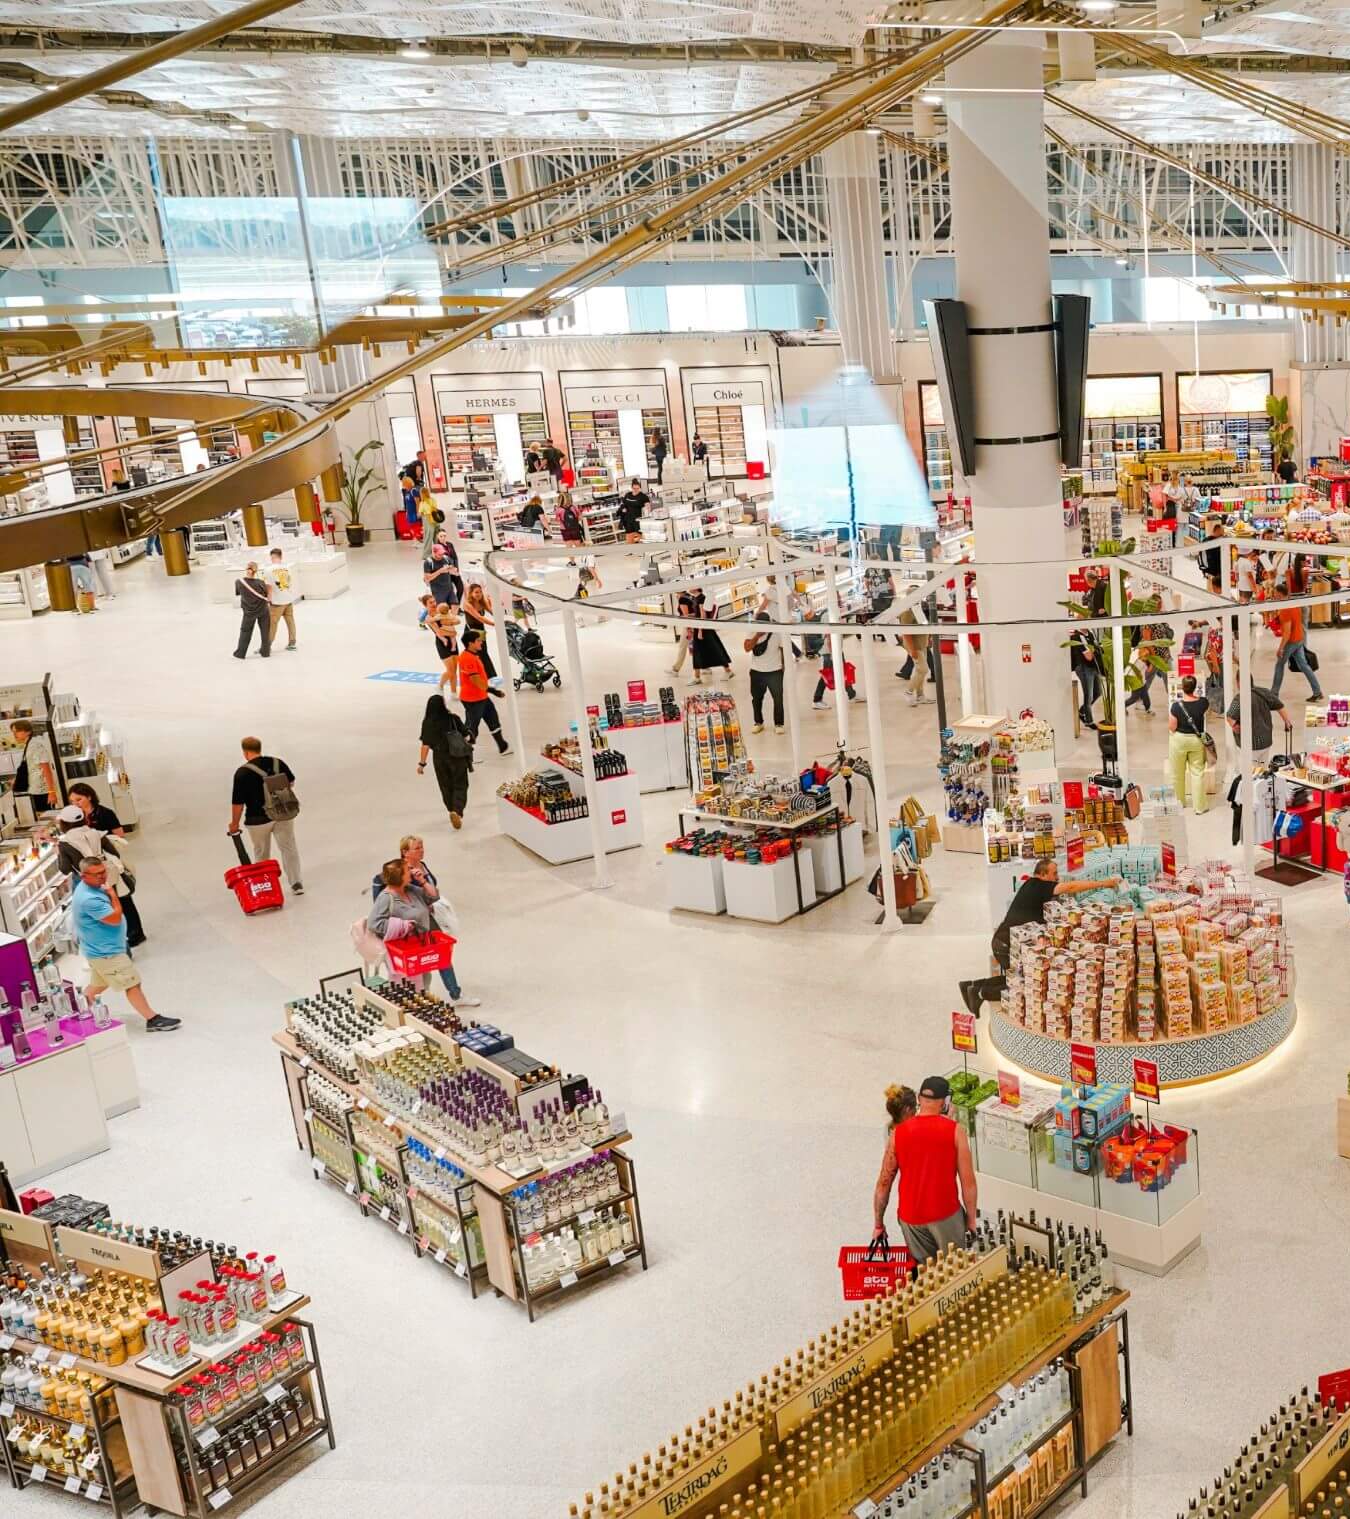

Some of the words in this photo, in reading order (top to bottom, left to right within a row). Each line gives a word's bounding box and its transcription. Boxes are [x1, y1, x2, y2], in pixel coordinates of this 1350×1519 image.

[591, 394, 641, 404] GUCCI
[713, 388, 743, 401] Chloé
[91, 1247, 120, 1261] TEQUILA
